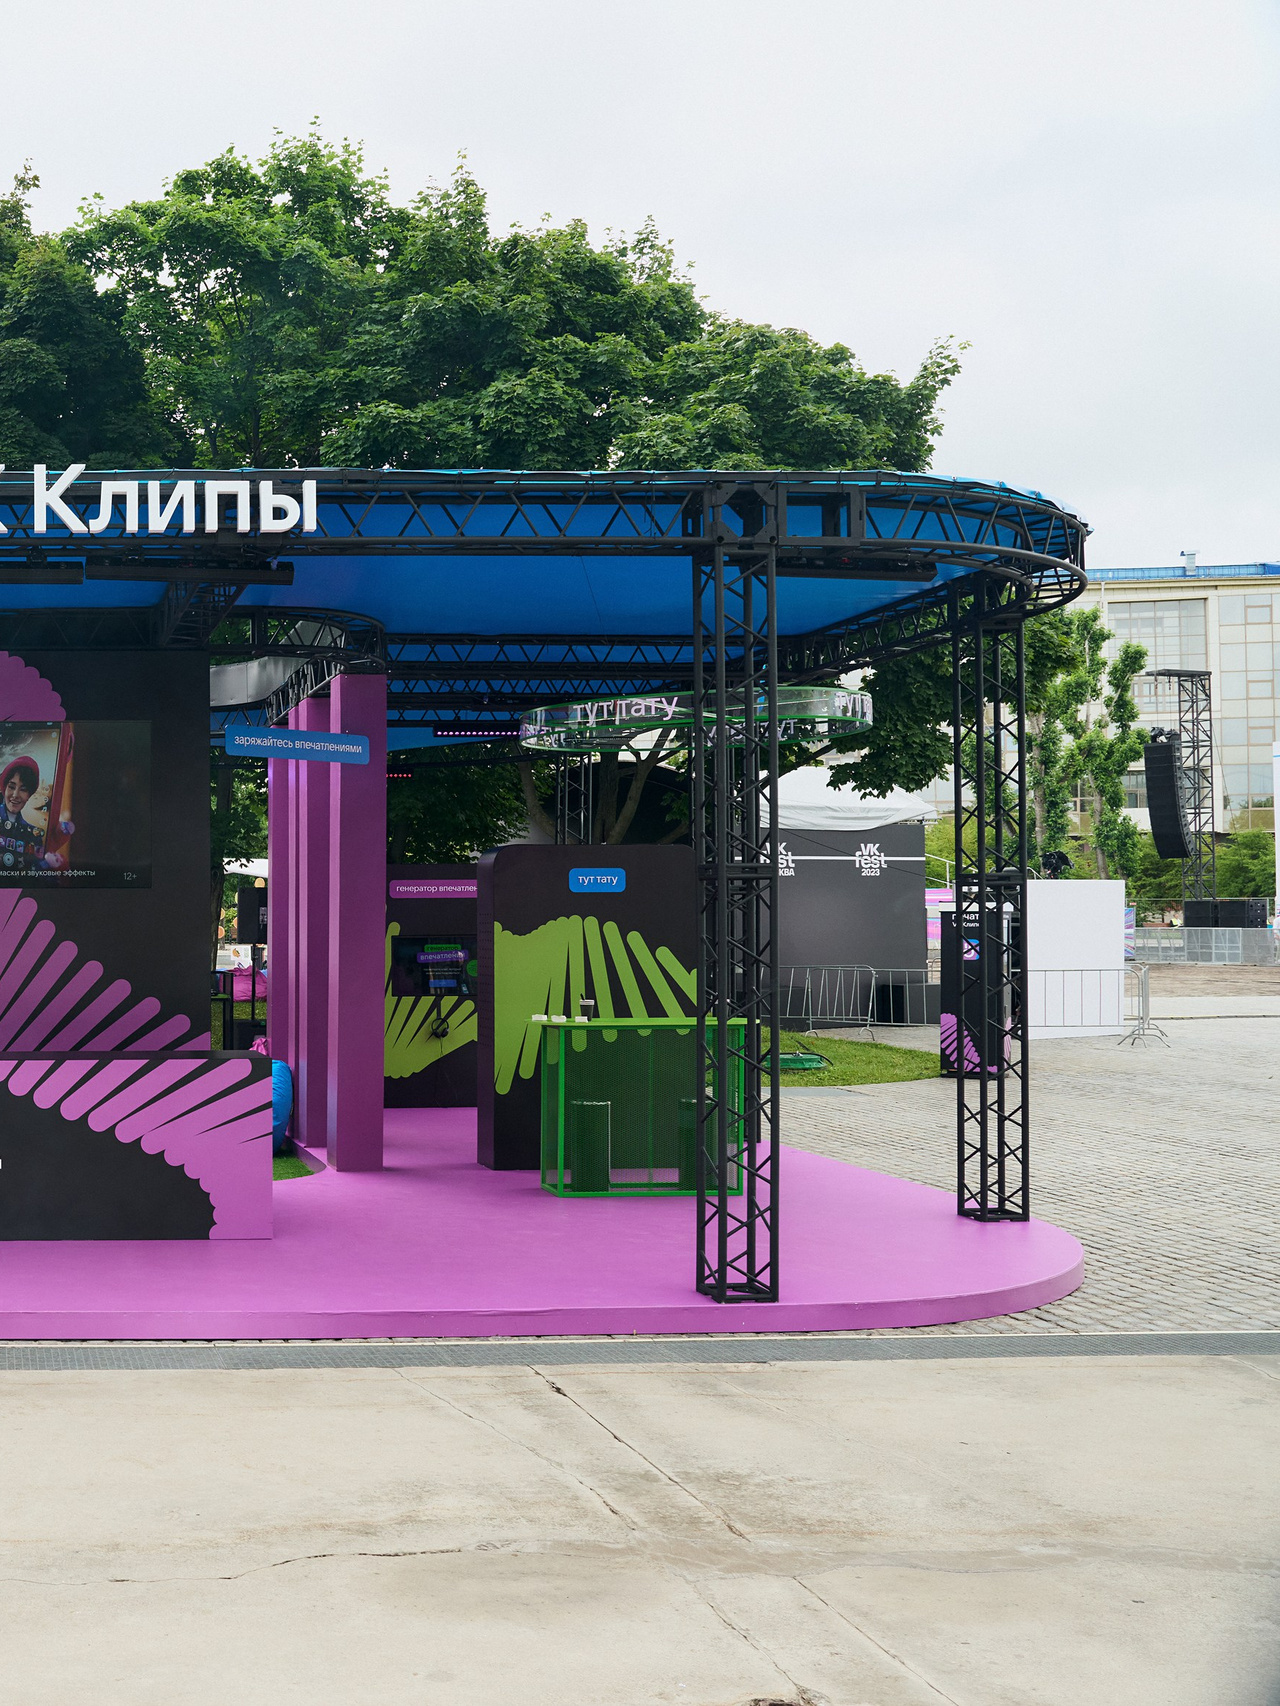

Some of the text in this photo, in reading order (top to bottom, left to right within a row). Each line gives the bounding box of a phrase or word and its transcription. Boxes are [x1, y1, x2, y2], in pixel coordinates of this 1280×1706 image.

[33, 464, 317, 534] Клипы
[573, 696, 679, 726] тут тату
[234, 735, 362, 753] заряжайтесь впечатлениями
[860, 843, 880, 856] VK
[855, 851, 888, 869] fest
[27, 870, 61, 878] звуковые
[63, 870, 96, 878] эффекты
[123, 872, 137, 880] 12+
[779, 868, 795, 877] КВА
[861, 868, 880, 877] 2023
[578, 876, 618, 886] тут тату
[396, 885, 477, 894] генератор впечатлен
